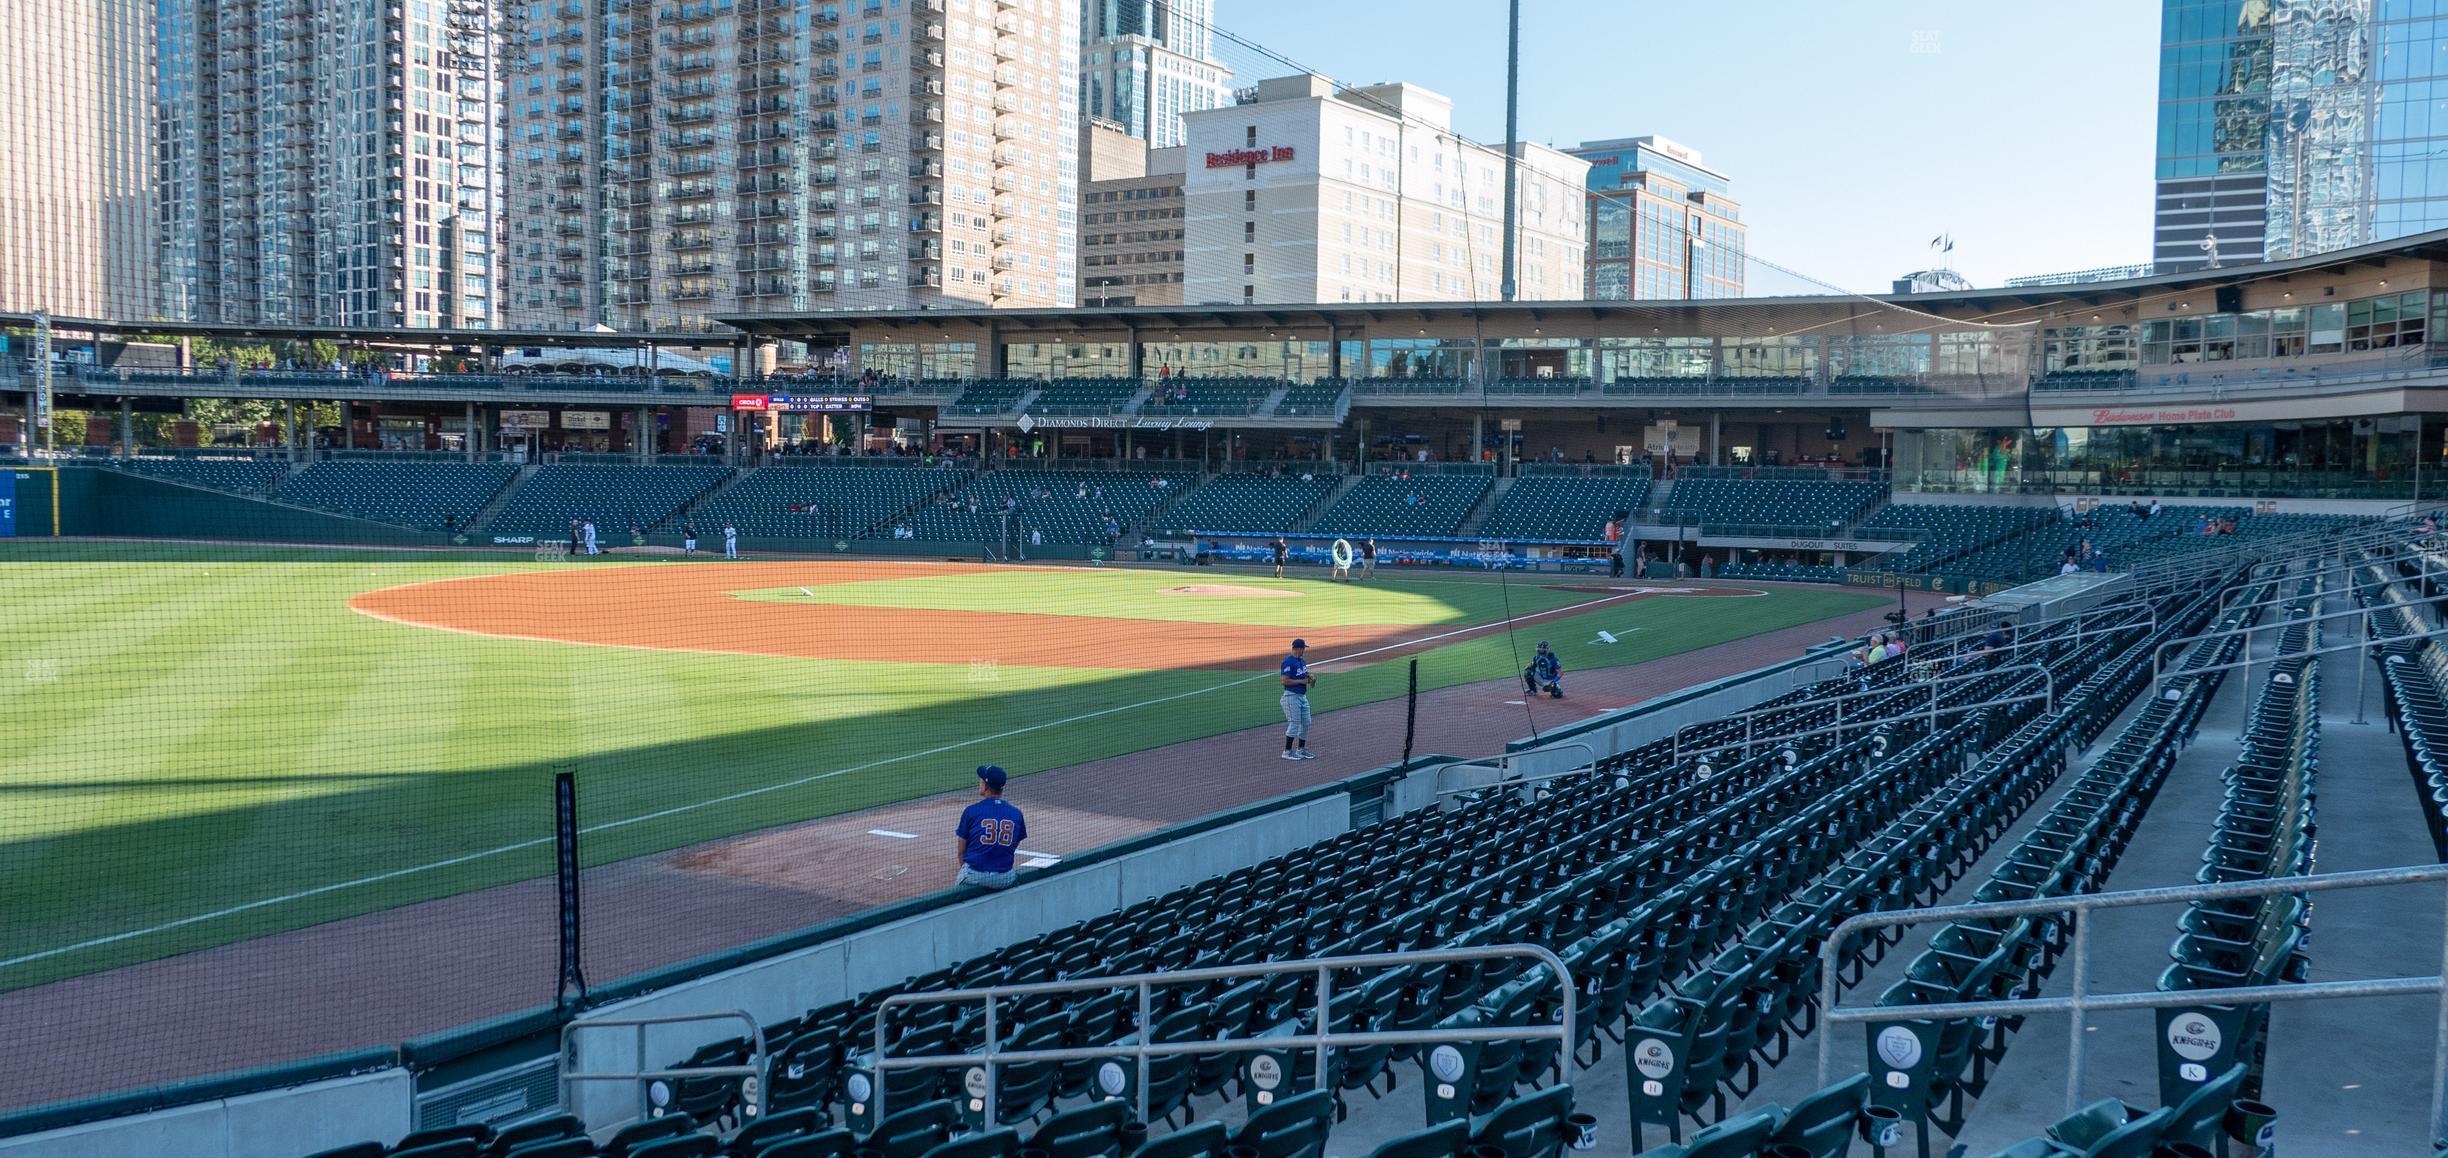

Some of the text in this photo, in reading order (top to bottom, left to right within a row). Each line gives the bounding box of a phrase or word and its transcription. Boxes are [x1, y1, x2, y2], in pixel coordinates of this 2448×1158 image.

[1206, 145, 1294, 168] Residence Inn
[2159, 411, 2186, 421] Home
[2188, 410, 2212, 420] Plate
[2214, 408, 2236, 419] Club
[1038, 417, 1215, 431] DIAMONDS DIRECT Luxury Lounge
[494, 536, 534, 544] SHARP
[1791, 541, 1858, 550] DUGOUT SUITES
[1847, 573, 1921, 588] TRUIST FIELD
[980, 819, 1014, 846] 38
[2172, 1035, 2216, 1050] KNIGHTS
[1638, 1057, 1670, 1070] KNIGHTS
[2189, 1067, 2198, 1078] K
[1442, 1090, 1450, 1098] G
[1649, 1084, 1657, 1092] H
